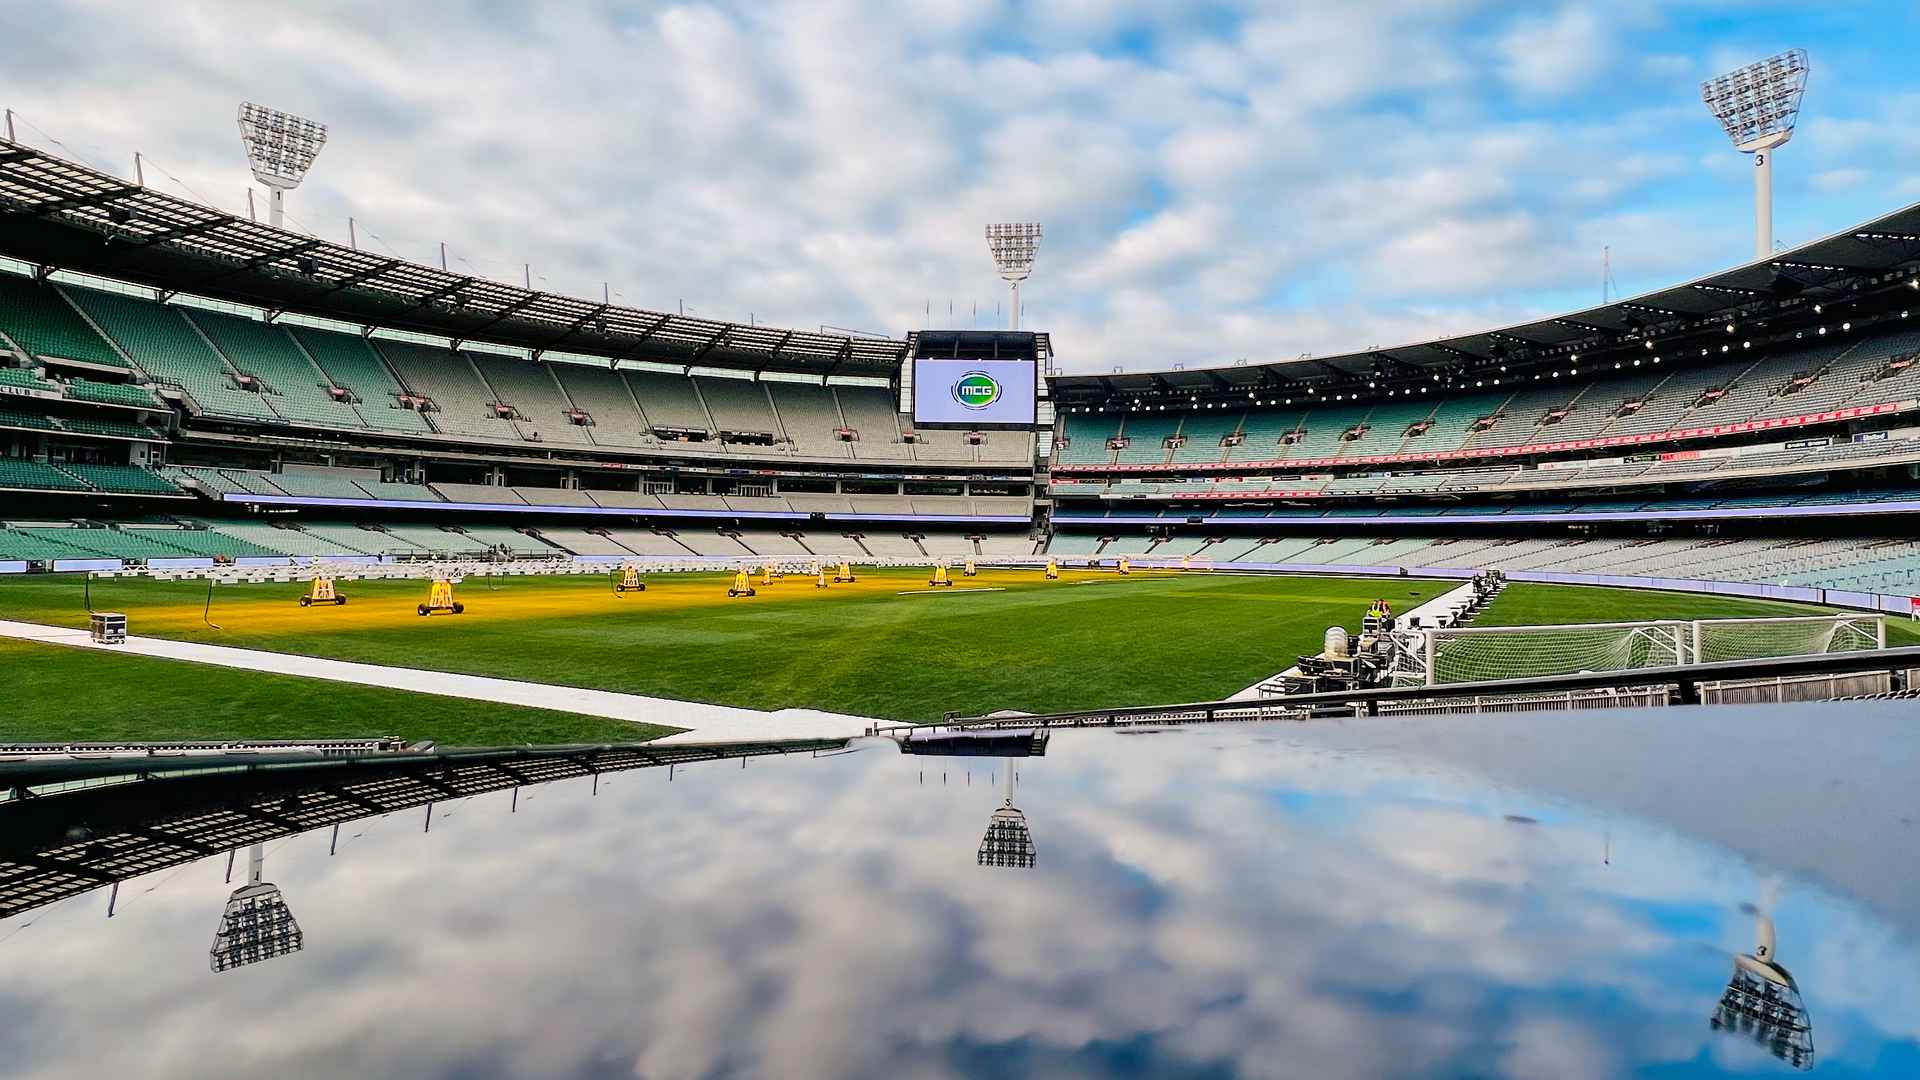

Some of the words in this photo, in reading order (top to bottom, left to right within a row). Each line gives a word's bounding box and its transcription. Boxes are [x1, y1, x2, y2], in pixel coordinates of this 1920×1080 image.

[1755, 154, 1764, 167] 3
[276, 191, 281, 201] 1
[0, 386, 31, 396] CLUB
[961, 385, 993, 396] MCG
